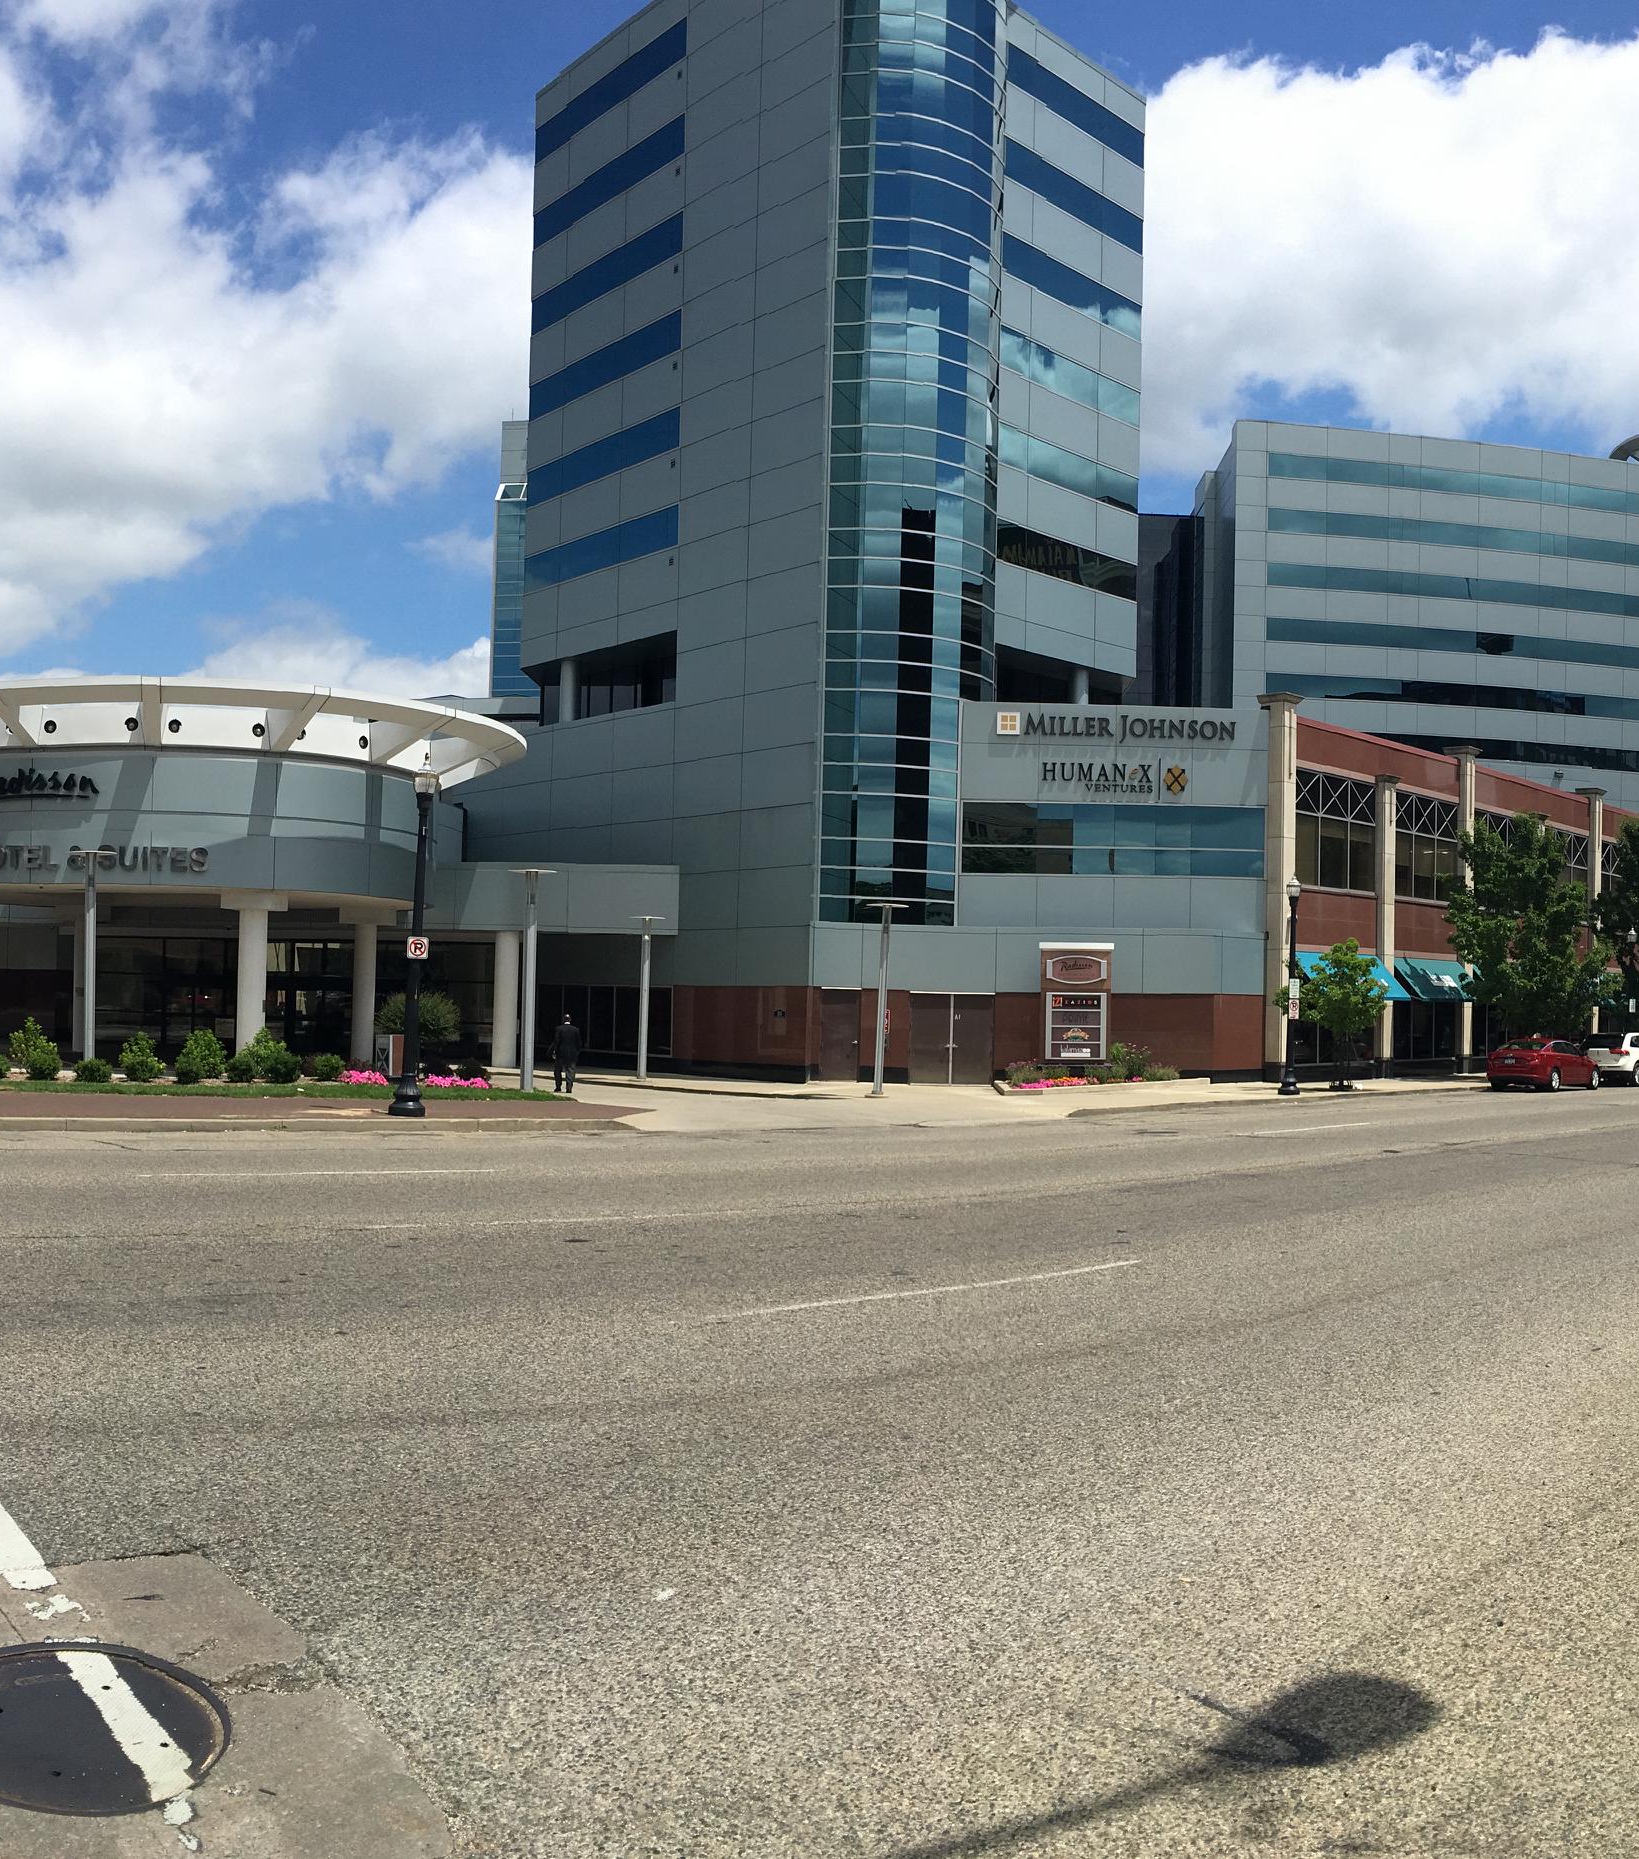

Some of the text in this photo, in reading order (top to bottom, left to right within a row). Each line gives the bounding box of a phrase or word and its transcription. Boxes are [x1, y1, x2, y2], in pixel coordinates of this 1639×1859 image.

[1024, 712, 1237, 744] MILLER JOHNSON
[1085, 783, 1154, 793] VENTURES
[95, 845, 210, 873] SUITES
